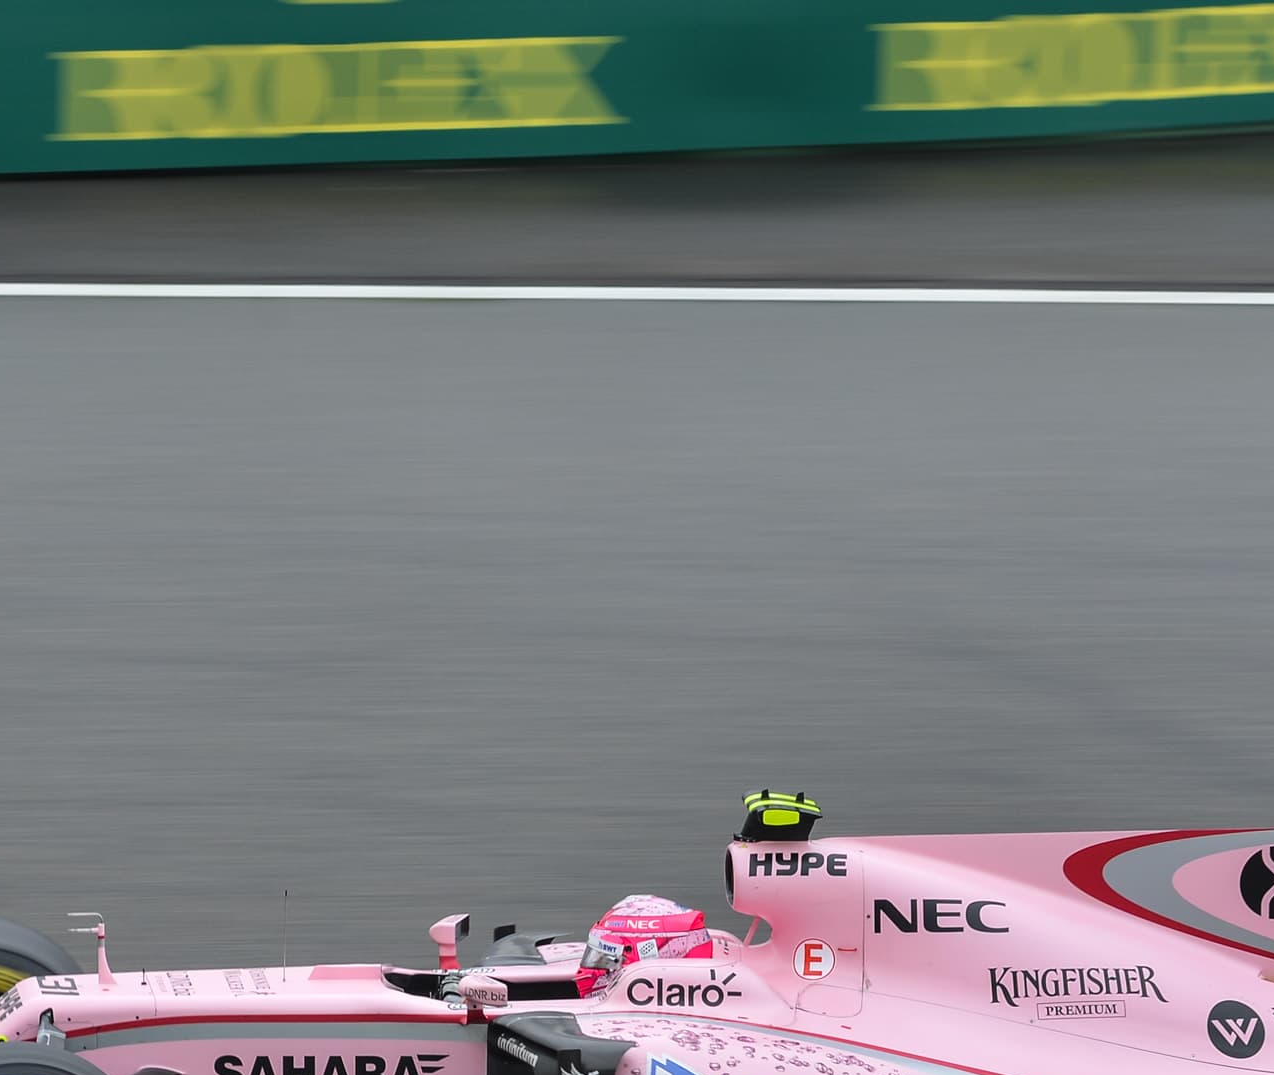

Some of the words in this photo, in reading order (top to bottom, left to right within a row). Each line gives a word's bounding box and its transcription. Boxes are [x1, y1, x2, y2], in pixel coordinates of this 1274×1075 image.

[749, 853, 847, 877] HYPE
[626, 920, 660, 929] NEC
[874, 899, 1009, 934] NEC
[803, 944, 823, 976] E
[627, 978, 724, 1007] Claro
[988, 966, 1169, 1007] KINGFISHER
[1046, 1004, 1117, 1016] PREMIUM
[497, 1033, 538, 1068] infinitum
